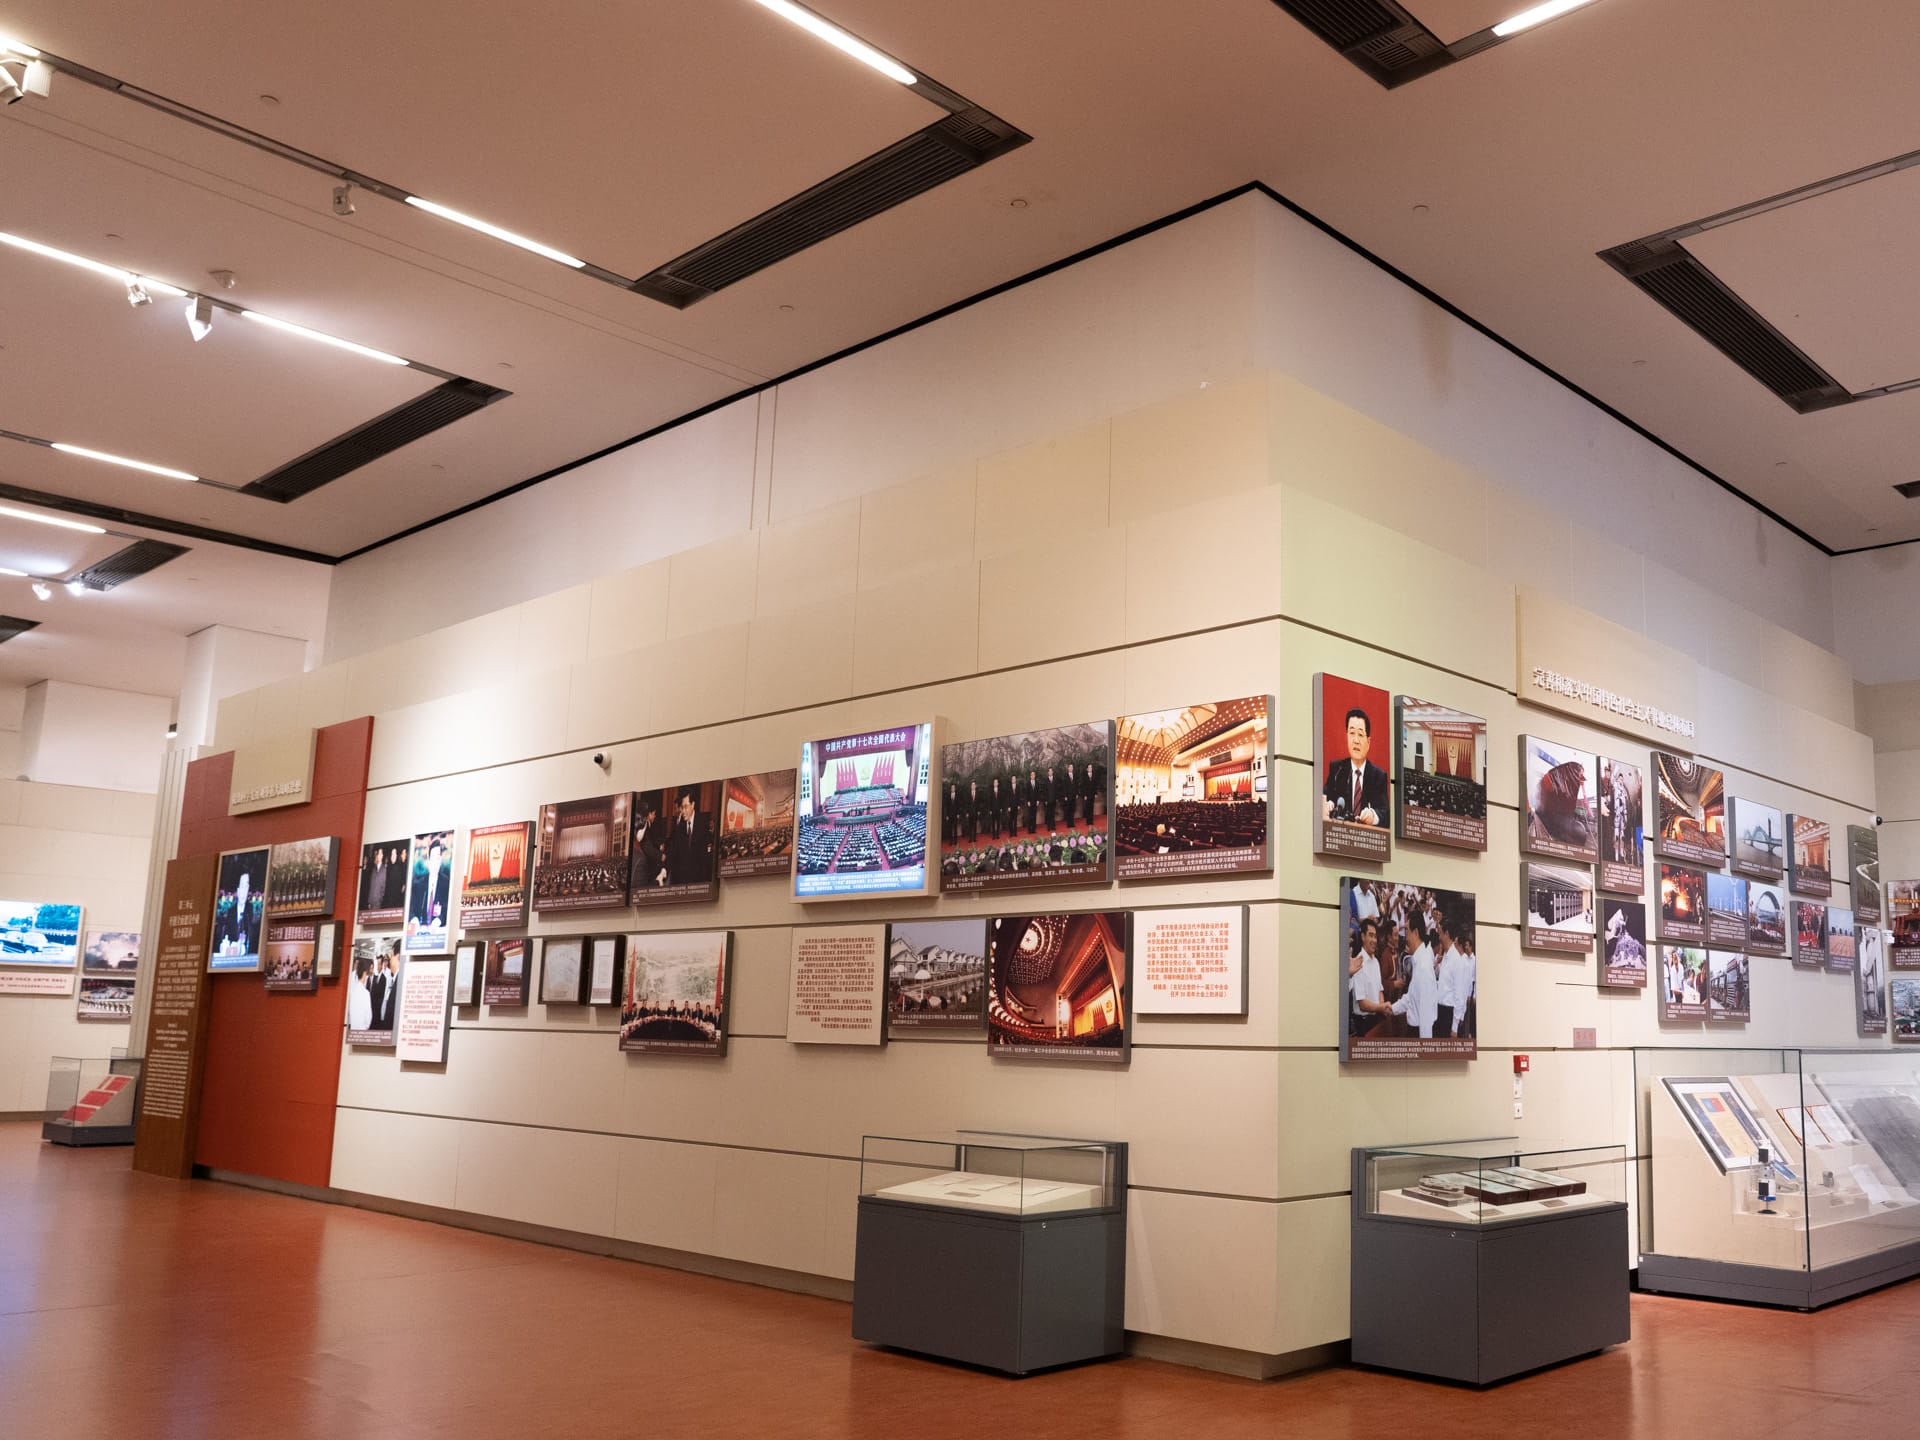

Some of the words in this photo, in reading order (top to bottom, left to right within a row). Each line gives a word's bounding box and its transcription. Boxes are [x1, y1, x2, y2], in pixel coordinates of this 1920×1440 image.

[825, 732, 907, 753] 中国共产党第十七次全国代表大会
